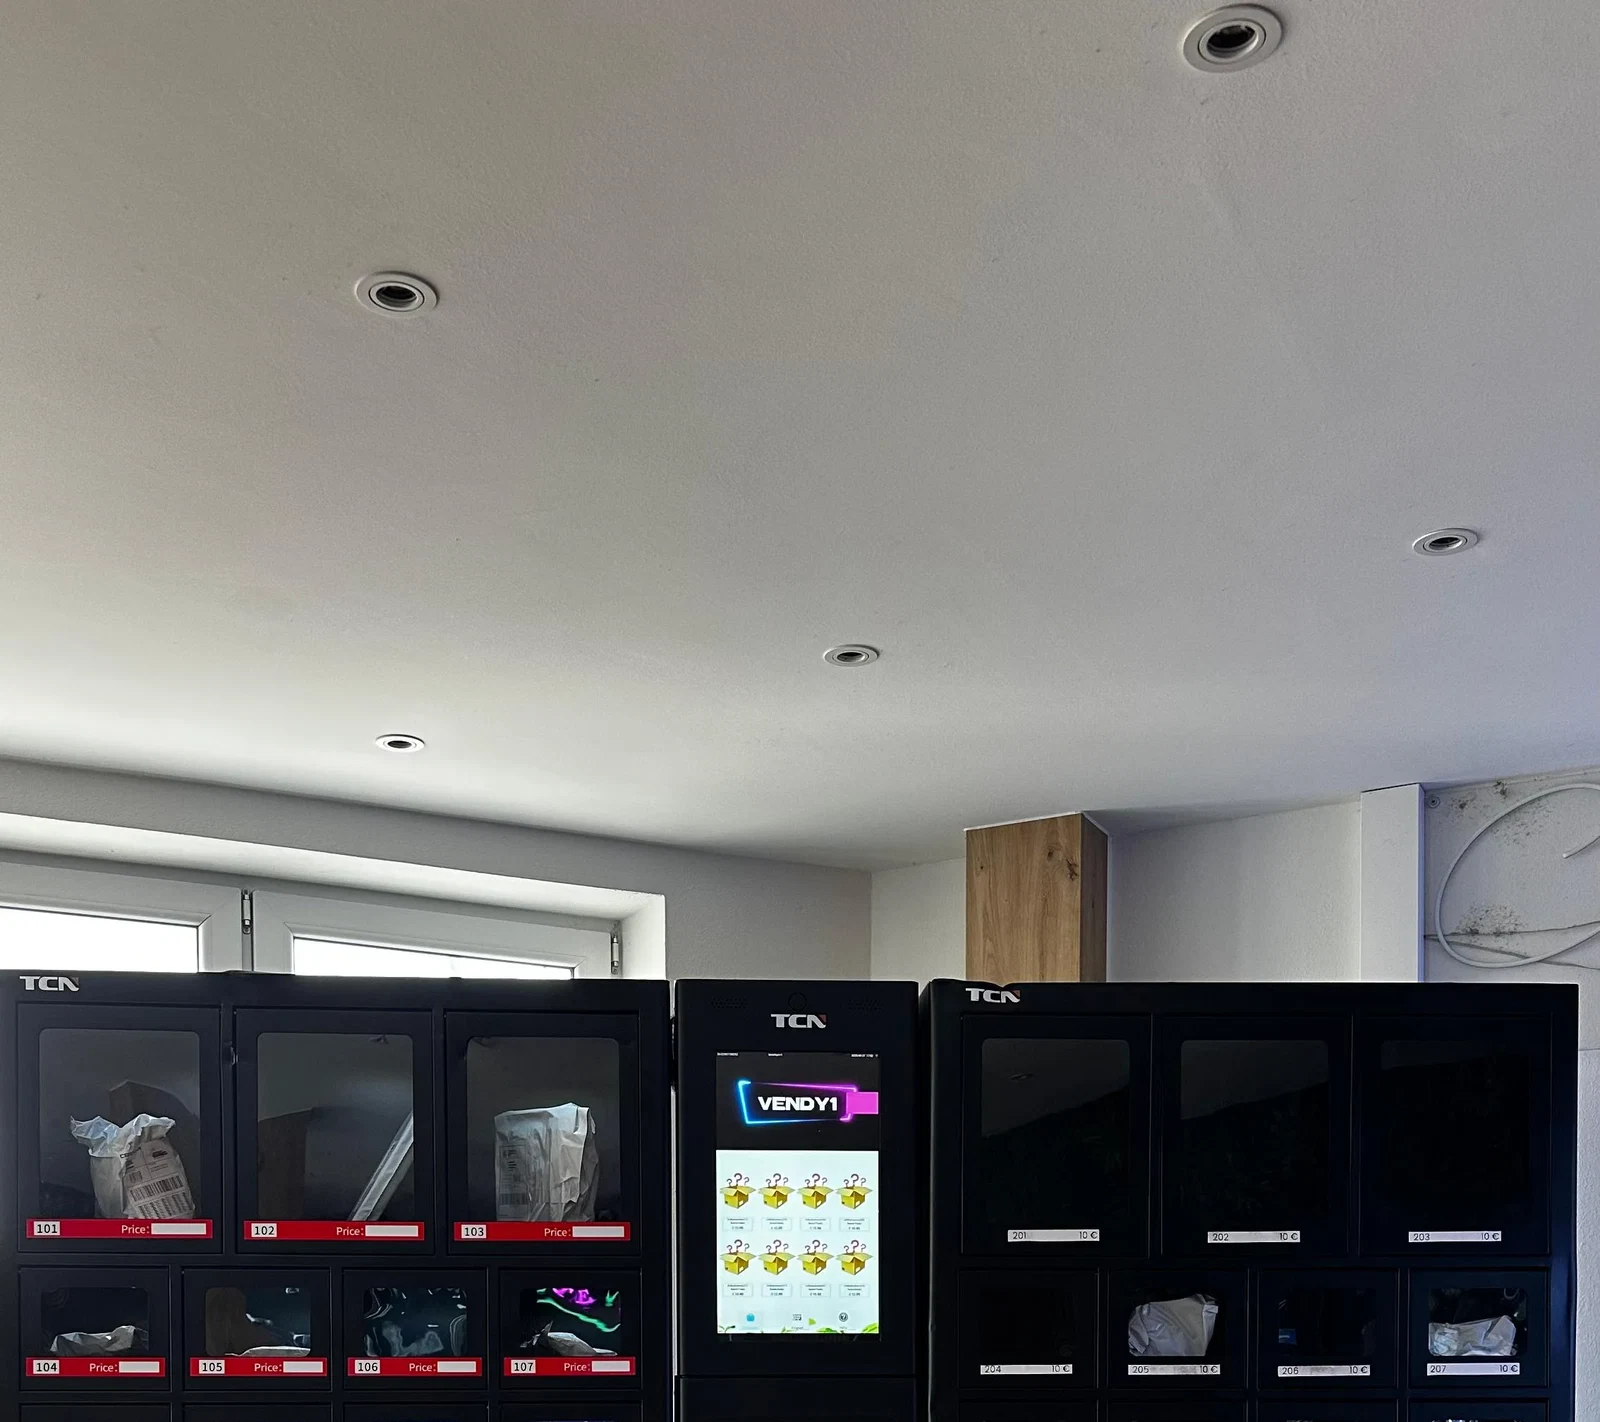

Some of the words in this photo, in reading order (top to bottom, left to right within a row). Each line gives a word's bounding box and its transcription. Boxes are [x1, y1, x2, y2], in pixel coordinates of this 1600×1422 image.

[19, 976, 80, 991] TCN
[965, 987, 1021, 1003] TCN
[770, 1013, 827, 1029] TCN
[757, 1096, 838, 1112] VENDY1
[37, 1223, 58, 1234] 101
[121, 1224, 150, 1235] Price:
[254, 1225, 275, 1236] 102
[336, 1226, 364, 1236] Price:
[464, 1226, 484, 1237] 103
[544, 1227, 571, 1237] Price:
[1012, 1231, 1027, 1240] 201
[1079, 1230, 1088, 1240] 10
[1089, 1230, 1098, 1240] €
[1212, 1232, 1229, 1242] 202
[1278, 1232, 1289, 1241] 10
[1290, 1232, 1299, 1241] €
[1413, 1232, 1431, 1242] 203
[1480, 1232, 1490, 1241] 10
[1491, 1232, 1500, 1241] €
[36, 1362, 58, 1372] 104
[89, 1363, 118, 1373] Price:
[202, 1362, 223, 1372] 105
[254, 1362, 282, 1372] Price:
[358, 1362, 378, 1372] 106
[409, 1362, 436, 1372] Price:
[514, 1362, 534, 1372] 107
[563, 1361, 590, 1372] Price:
[984, 1365, 1002, 1374] 204
[1051, 1365, 1061, 1373] 10
[1062, 1365, 1070, 1373] €
[1132, 1365, 1150, 1374] 205
[1199, 1365, 1209, 1374] 10
[1210, 1365, 1218, 1374] €
[1281, 1366, 1299, 1375] 206
[1349, 1365, 1359, 1375] 10
[1360, 1365, 1368, 1374] €
[1430, 1364, 1447, 1374] 207
[1499, 1364, 1508, 1373] 10
[1509, 1364, 1519, 1373] €
